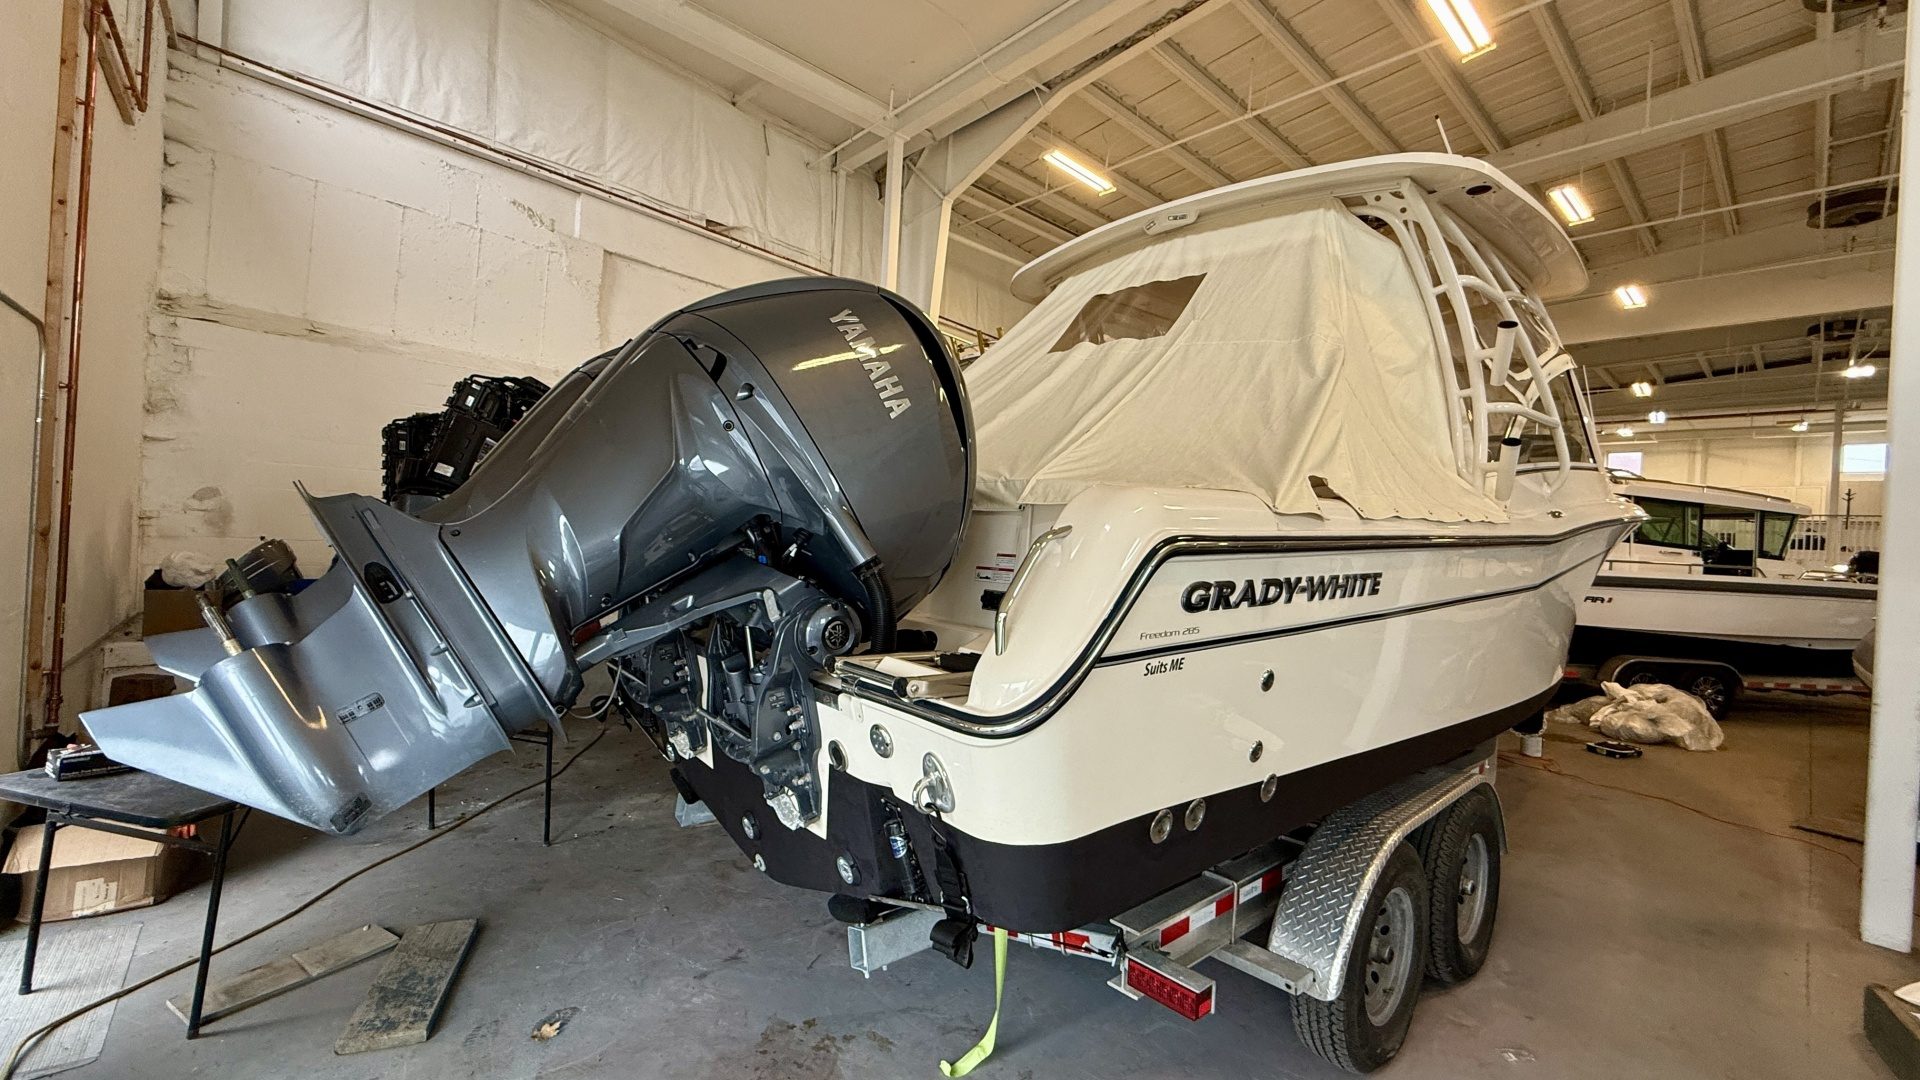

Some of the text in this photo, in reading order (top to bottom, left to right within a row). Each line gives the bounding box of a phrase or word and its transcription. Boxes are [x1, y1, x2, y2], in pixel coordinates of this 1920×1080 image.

[829, 308, 912, 420] YAMAHA
[1180, 572, 1383, 614] GRADY-WHITE
[1139, 629, 1181, 641] Freedom
[1143, 657, 1186, 677] Suits ME
